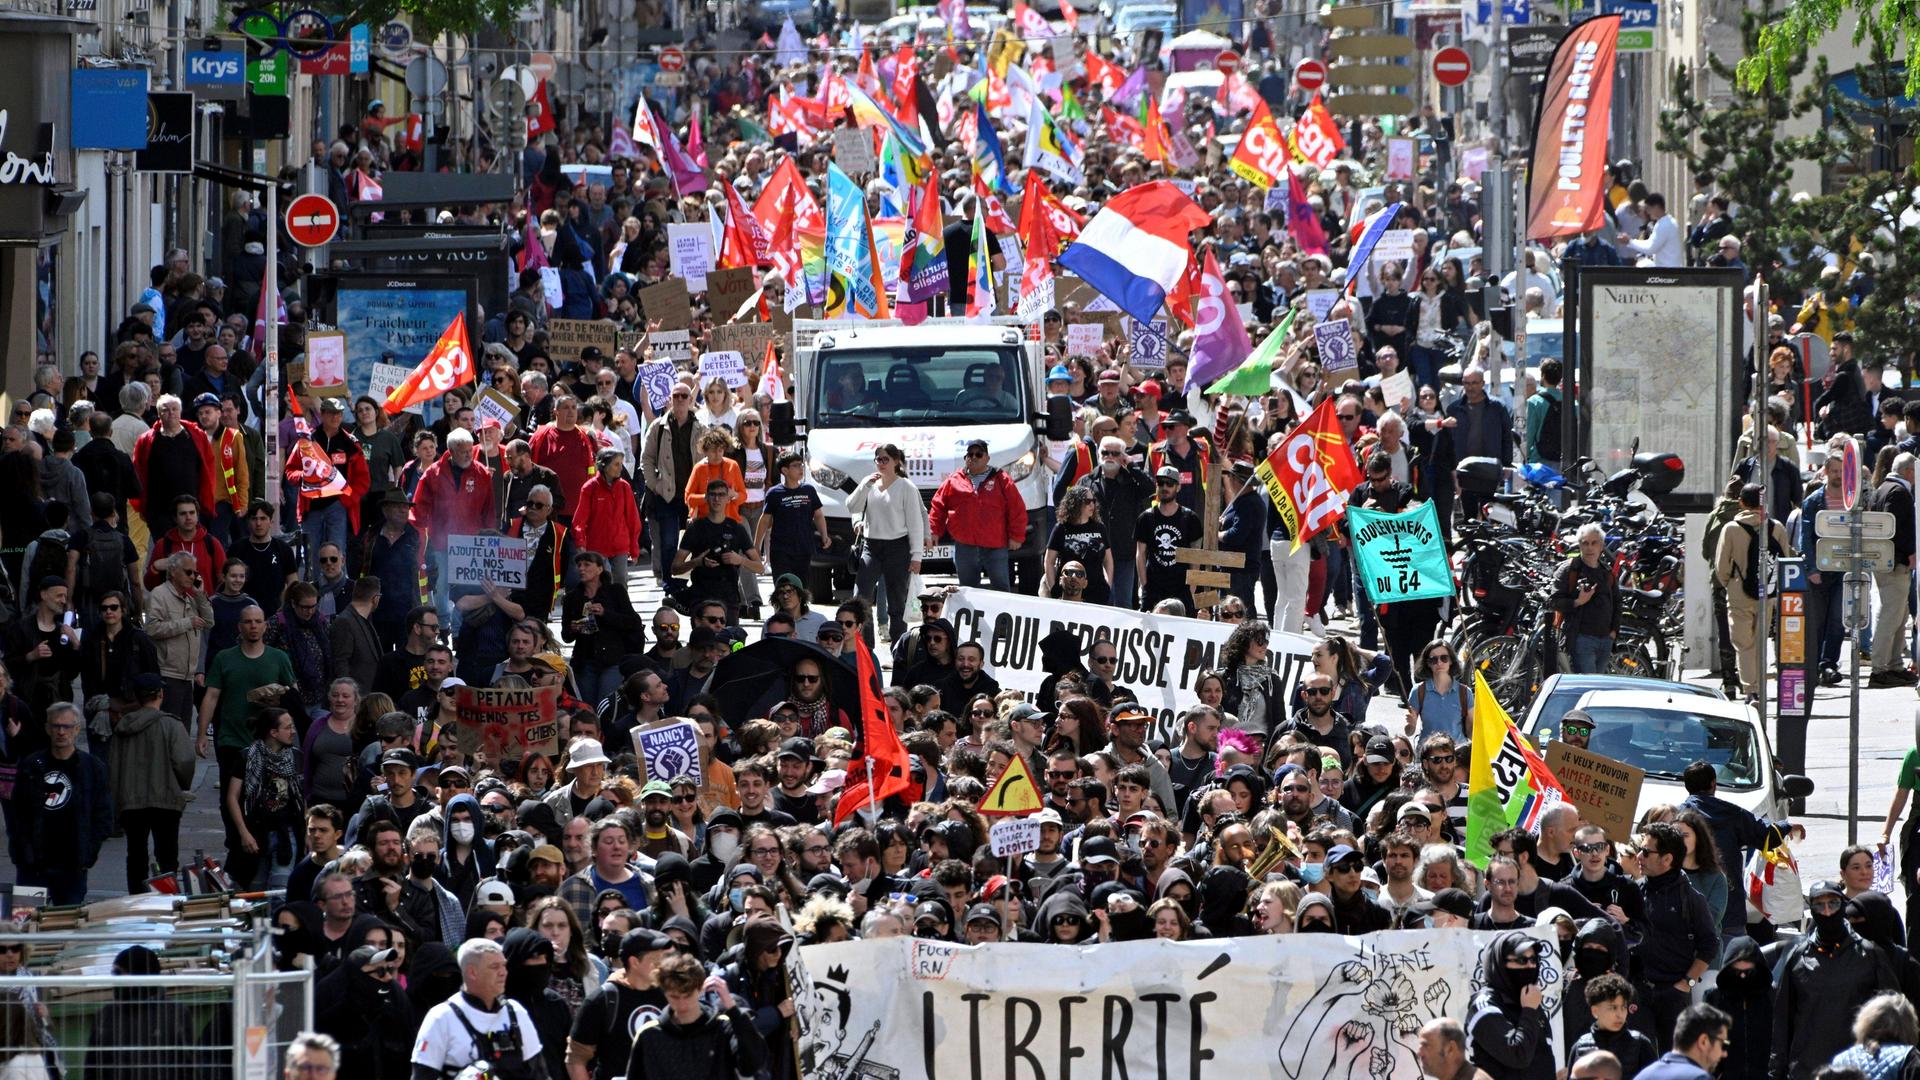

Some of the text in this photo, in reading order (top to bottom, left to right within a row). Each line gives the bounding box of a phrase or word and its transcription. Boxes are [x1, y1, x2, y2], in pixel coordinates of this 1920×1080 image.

[191, 57, 238, 78] Krys
[259, 73, 276, 83] 20h
[1557, 104, 1586, 191] POULETS
[650, 340, 691, 351] TUTTI
[719, 353, 730, 361] RN
[1261, 470, 1271, 482] UL
[1270, 481, 1280, 497] Val
[1277, 495, 1288, 511] De
[1287, 433, 1350, 532] cgt
[1065, 532, 1102, 540] L'AMOUR
[1355, 518, 1434, 546] SOULÈVEMENTS
[474, 537, 500, 547] LE RN
[448, 545, 526, 561] AJOUTE LA HAINE
[483, 558, 505, 570] NOS
[1377, 576, 1391, 593] DU
[1784, 565, 1800, 588] P
[1782, 596, 1803, 613] T2
[953, 607, 984, 643] CE
[989, 612, 1041, 671] QUI
[518, 709, 541, 724] TES
[649, 726, 685, 747] NANCY
[1561, 750, 1630, 784] JE VEUX POUVOIR
[1558, 766, 1592, 787] AIMER
[1592, 779, 1610, 794] SANS
[992, 821, 1040, 837] ATTENTION
[917, 943, 952, 960] FUCK
[919, 961, 943, 975] RN
